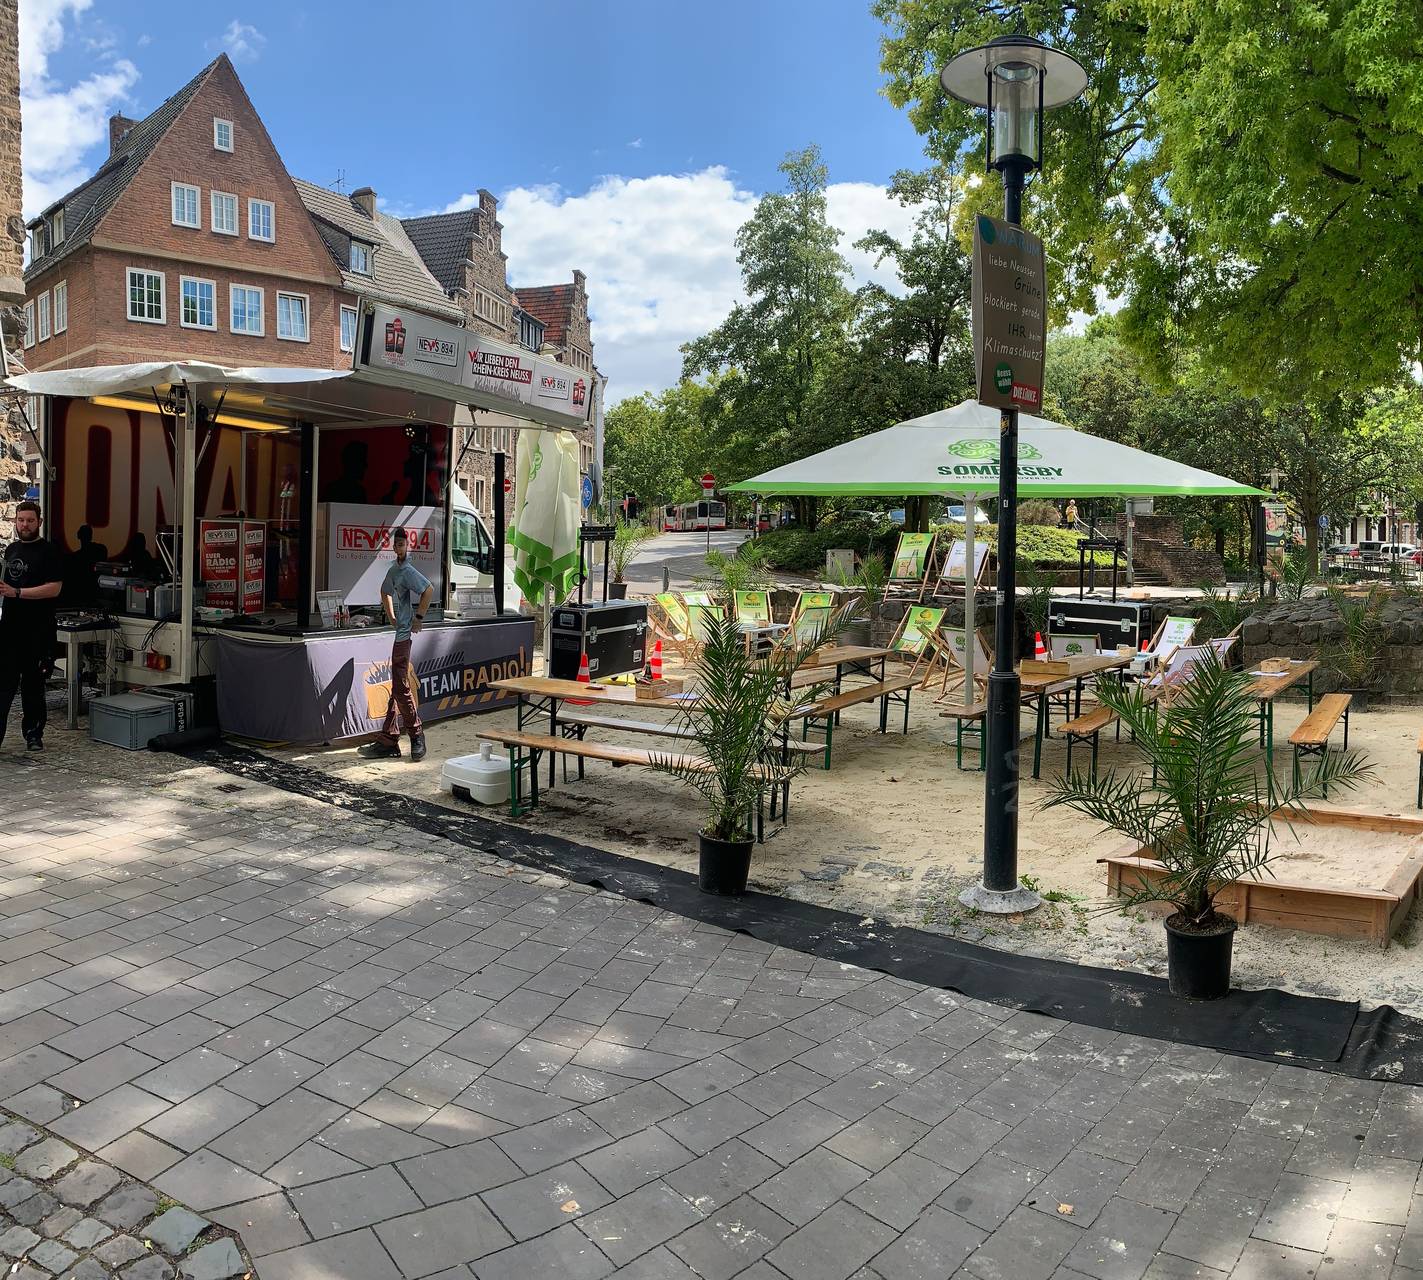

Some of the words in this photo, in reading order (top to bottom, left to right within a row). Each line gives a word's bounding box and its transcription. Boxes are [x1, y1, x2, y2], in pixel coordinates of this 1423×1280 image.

[989, 253, 1008, 268] liebe
[1010, 259, 1036, 278] Neusser
[1014, 276, 1041, 300] Grüne
[984, 292, 1018, 312] blockiert
[1008, 322, 1026, 338] IHR
[484, 352, 505, 368] LIEBEN
[505, 357, 518, 369] DEN
[472, 362, 509, 378] RHEIN-KREIS
[207, 558, 236, 567] RADIO
[420, 670, 461, 698] TEAM
